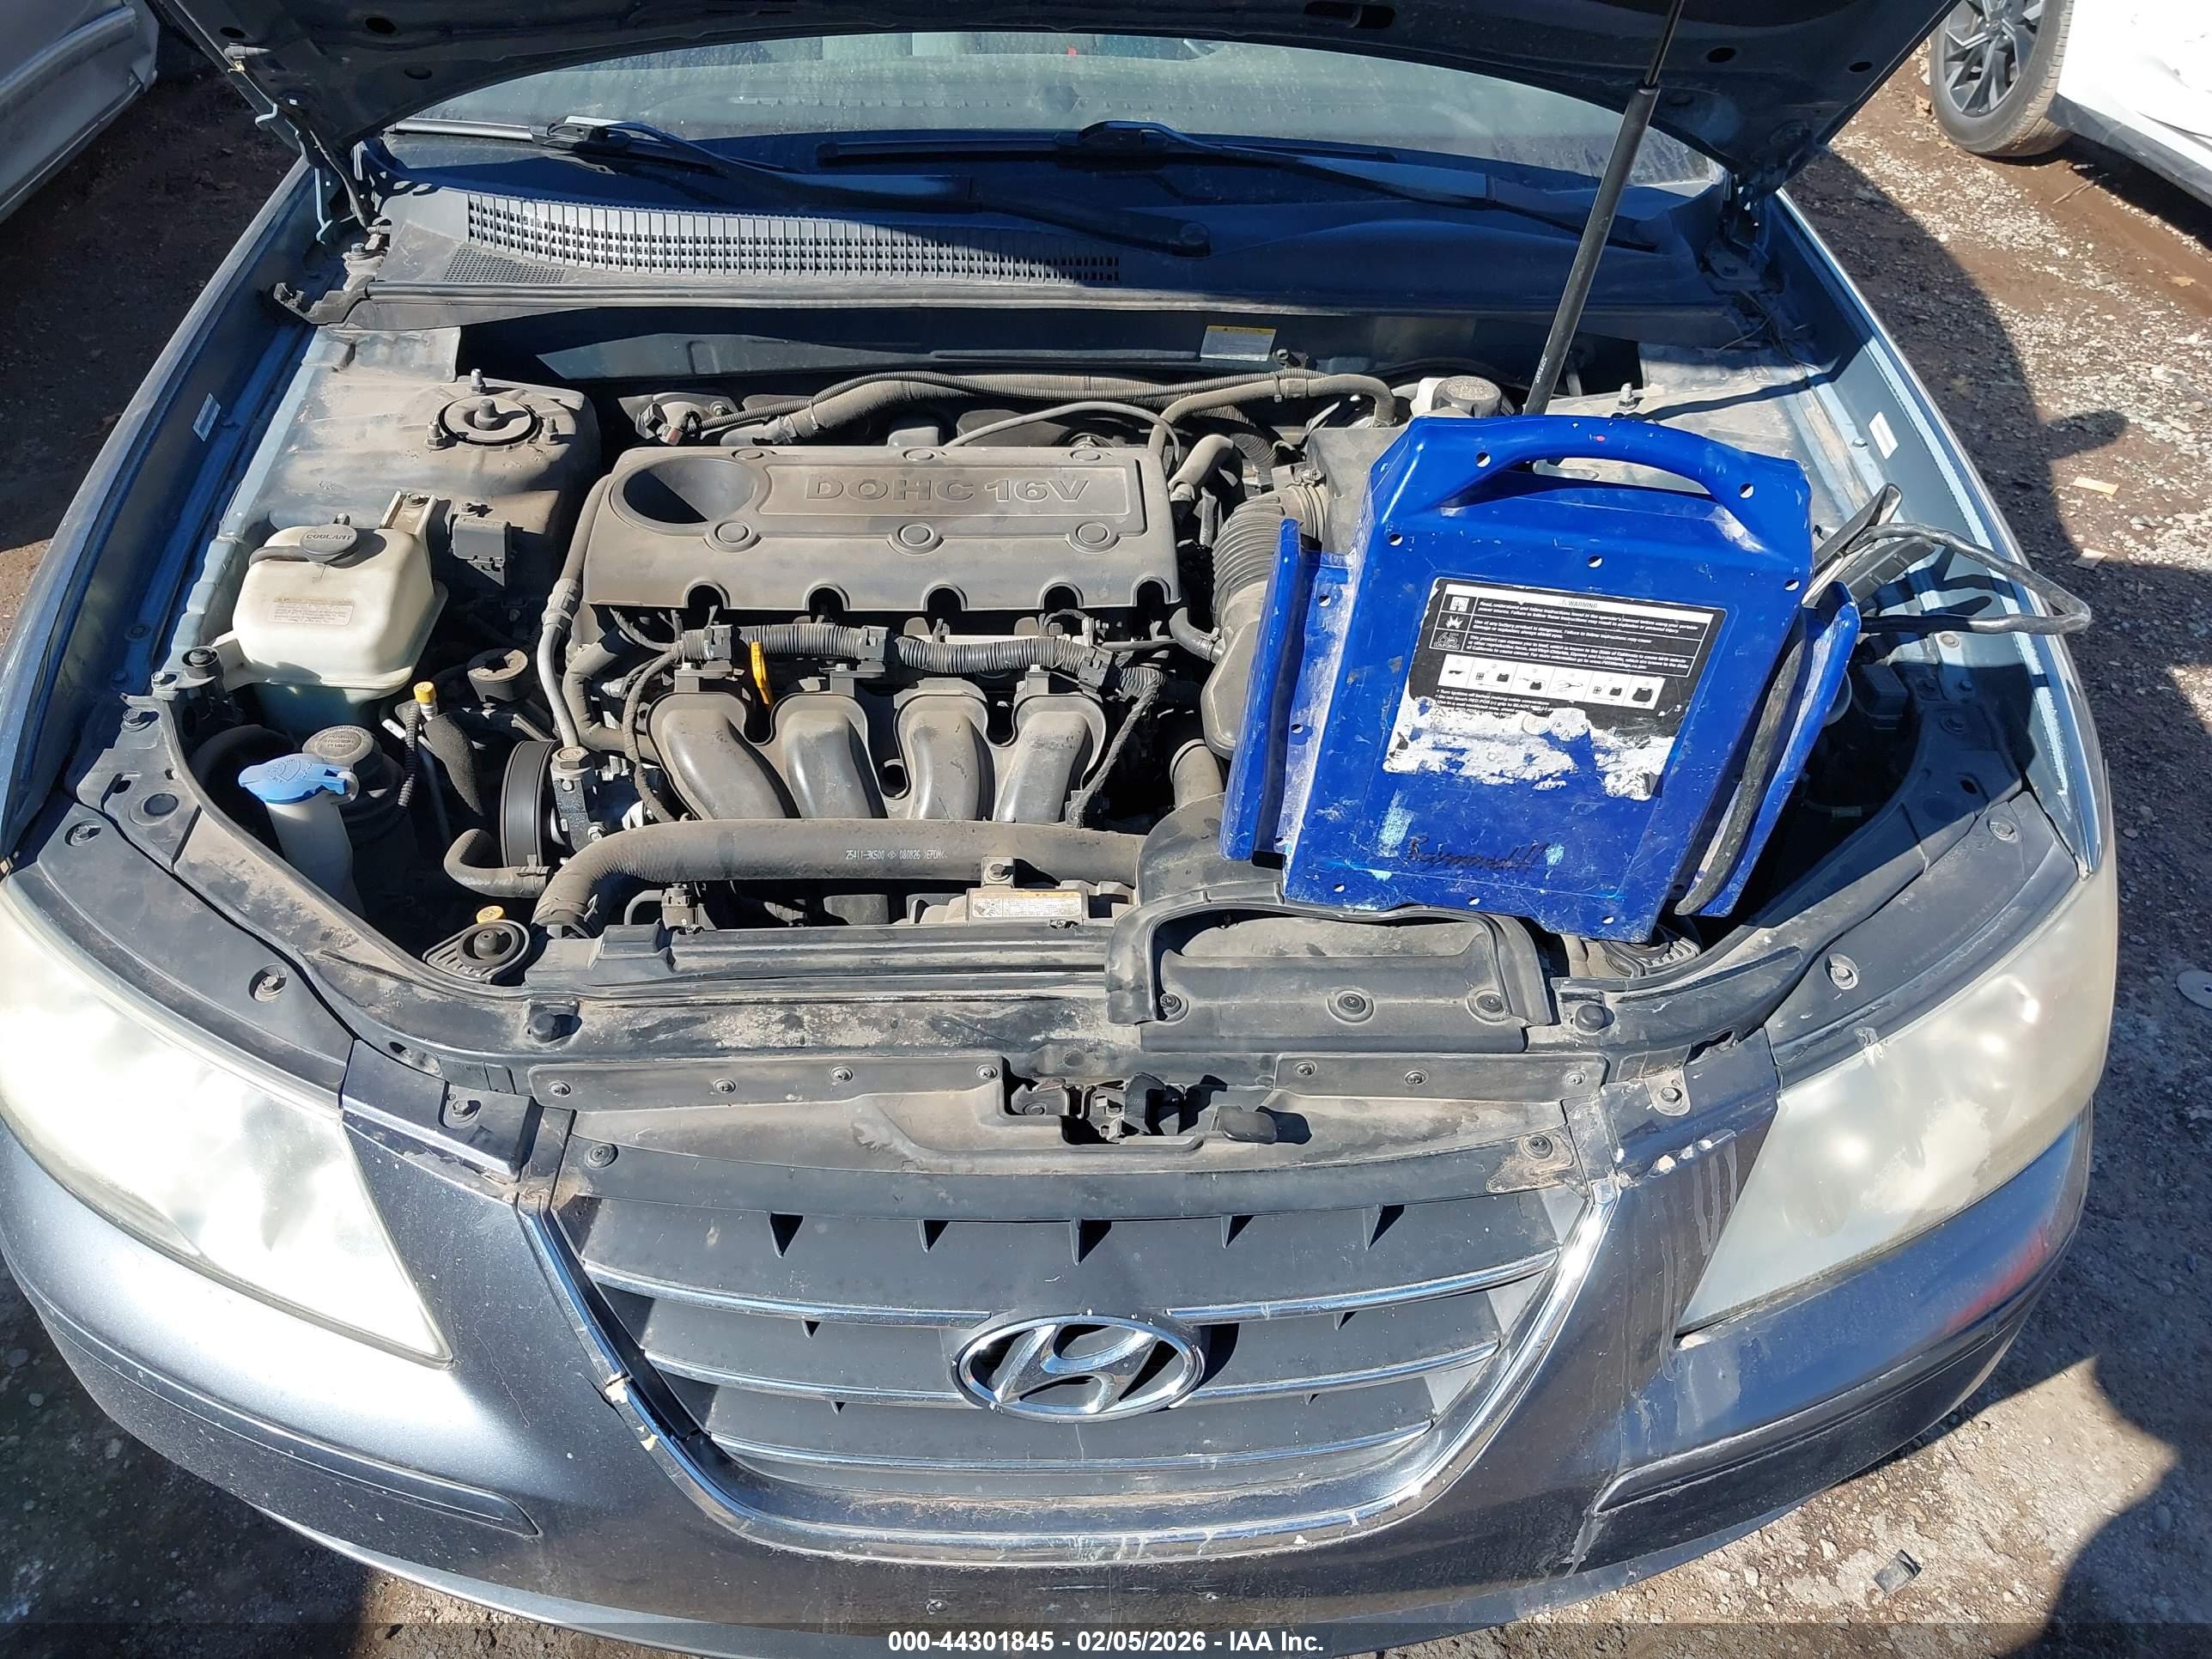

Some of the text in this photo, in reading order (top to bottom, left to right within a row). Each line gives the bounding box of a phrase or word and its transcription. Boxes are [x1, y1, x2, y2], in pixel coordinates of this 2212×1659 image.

[805, 478, 1090, 501] DOHC 16V
[1568, 600, 1598, 609] WARNING
